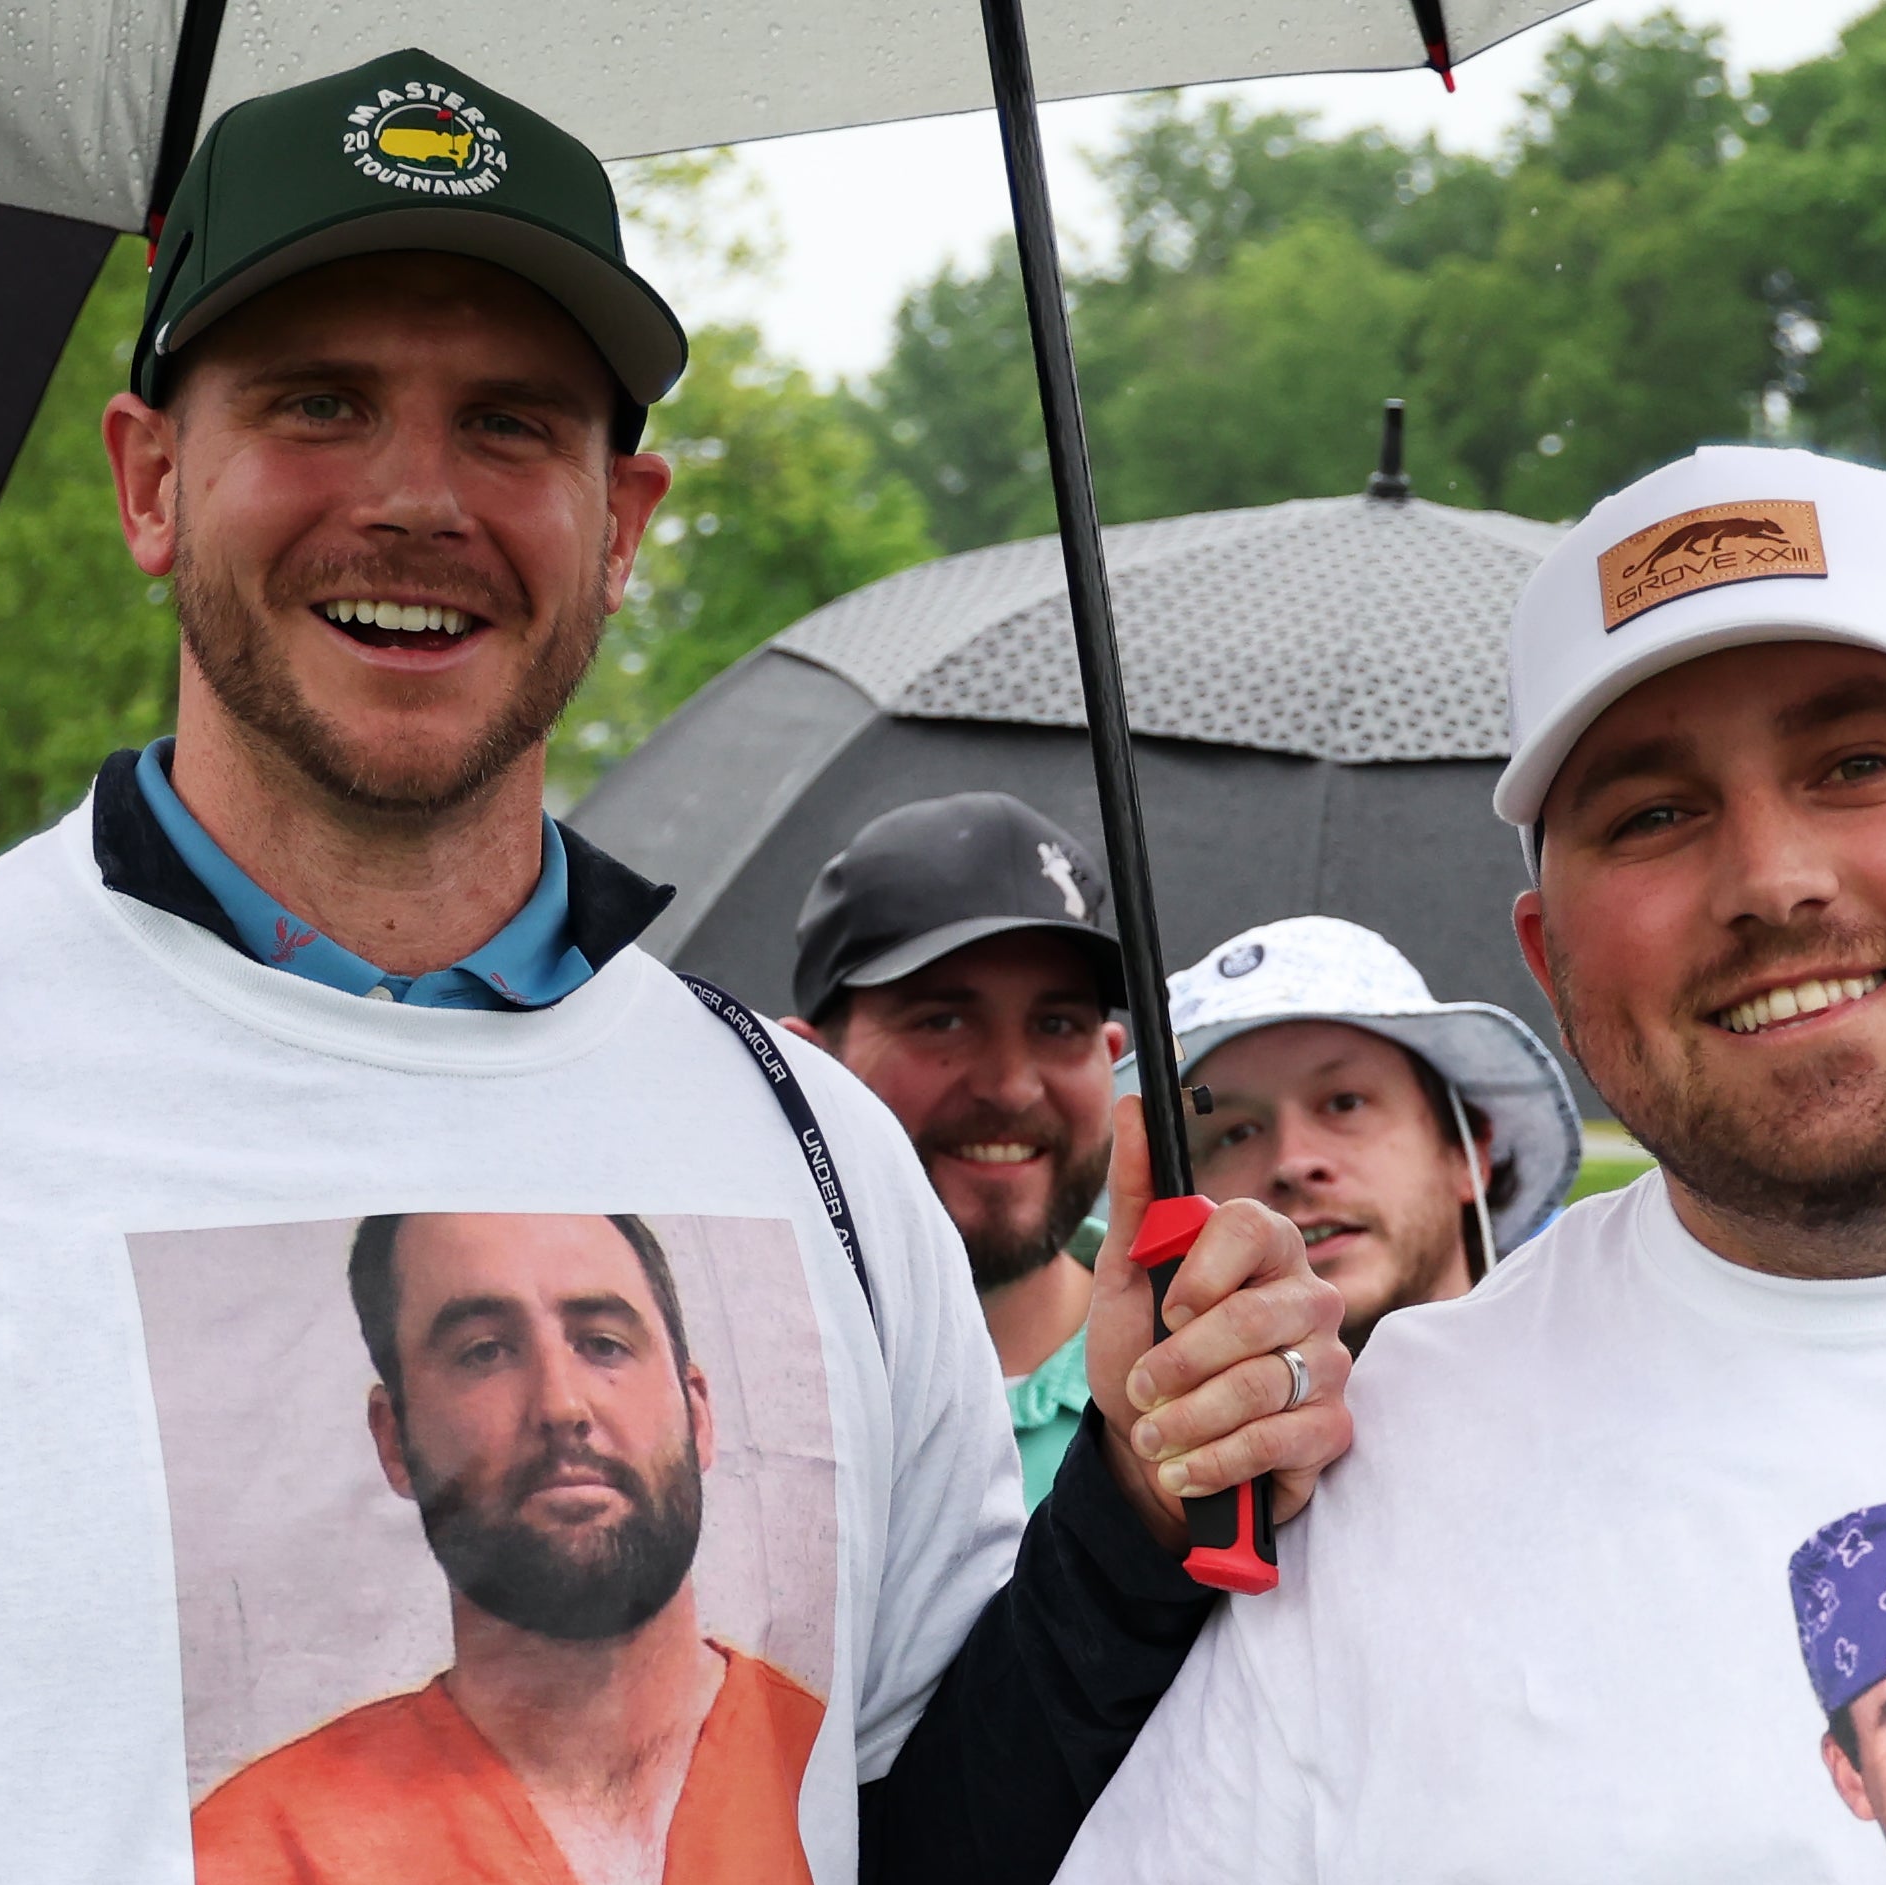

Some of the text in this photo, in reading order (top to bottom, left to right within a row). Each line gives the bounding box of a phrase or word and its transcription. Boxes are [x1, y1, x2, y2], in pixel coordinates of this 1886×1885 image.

[347, 81, 502, 142] MASTERS
[343, 130, 508, 172] 20 24
[354, 152, 501, 196] TOURNAMENT
[1616, 546, 1810, 608] GROVE XXIII
[723, 1004, 788, 1084] ARMOUR
[802, 1127, 843, 1218] UNDER
